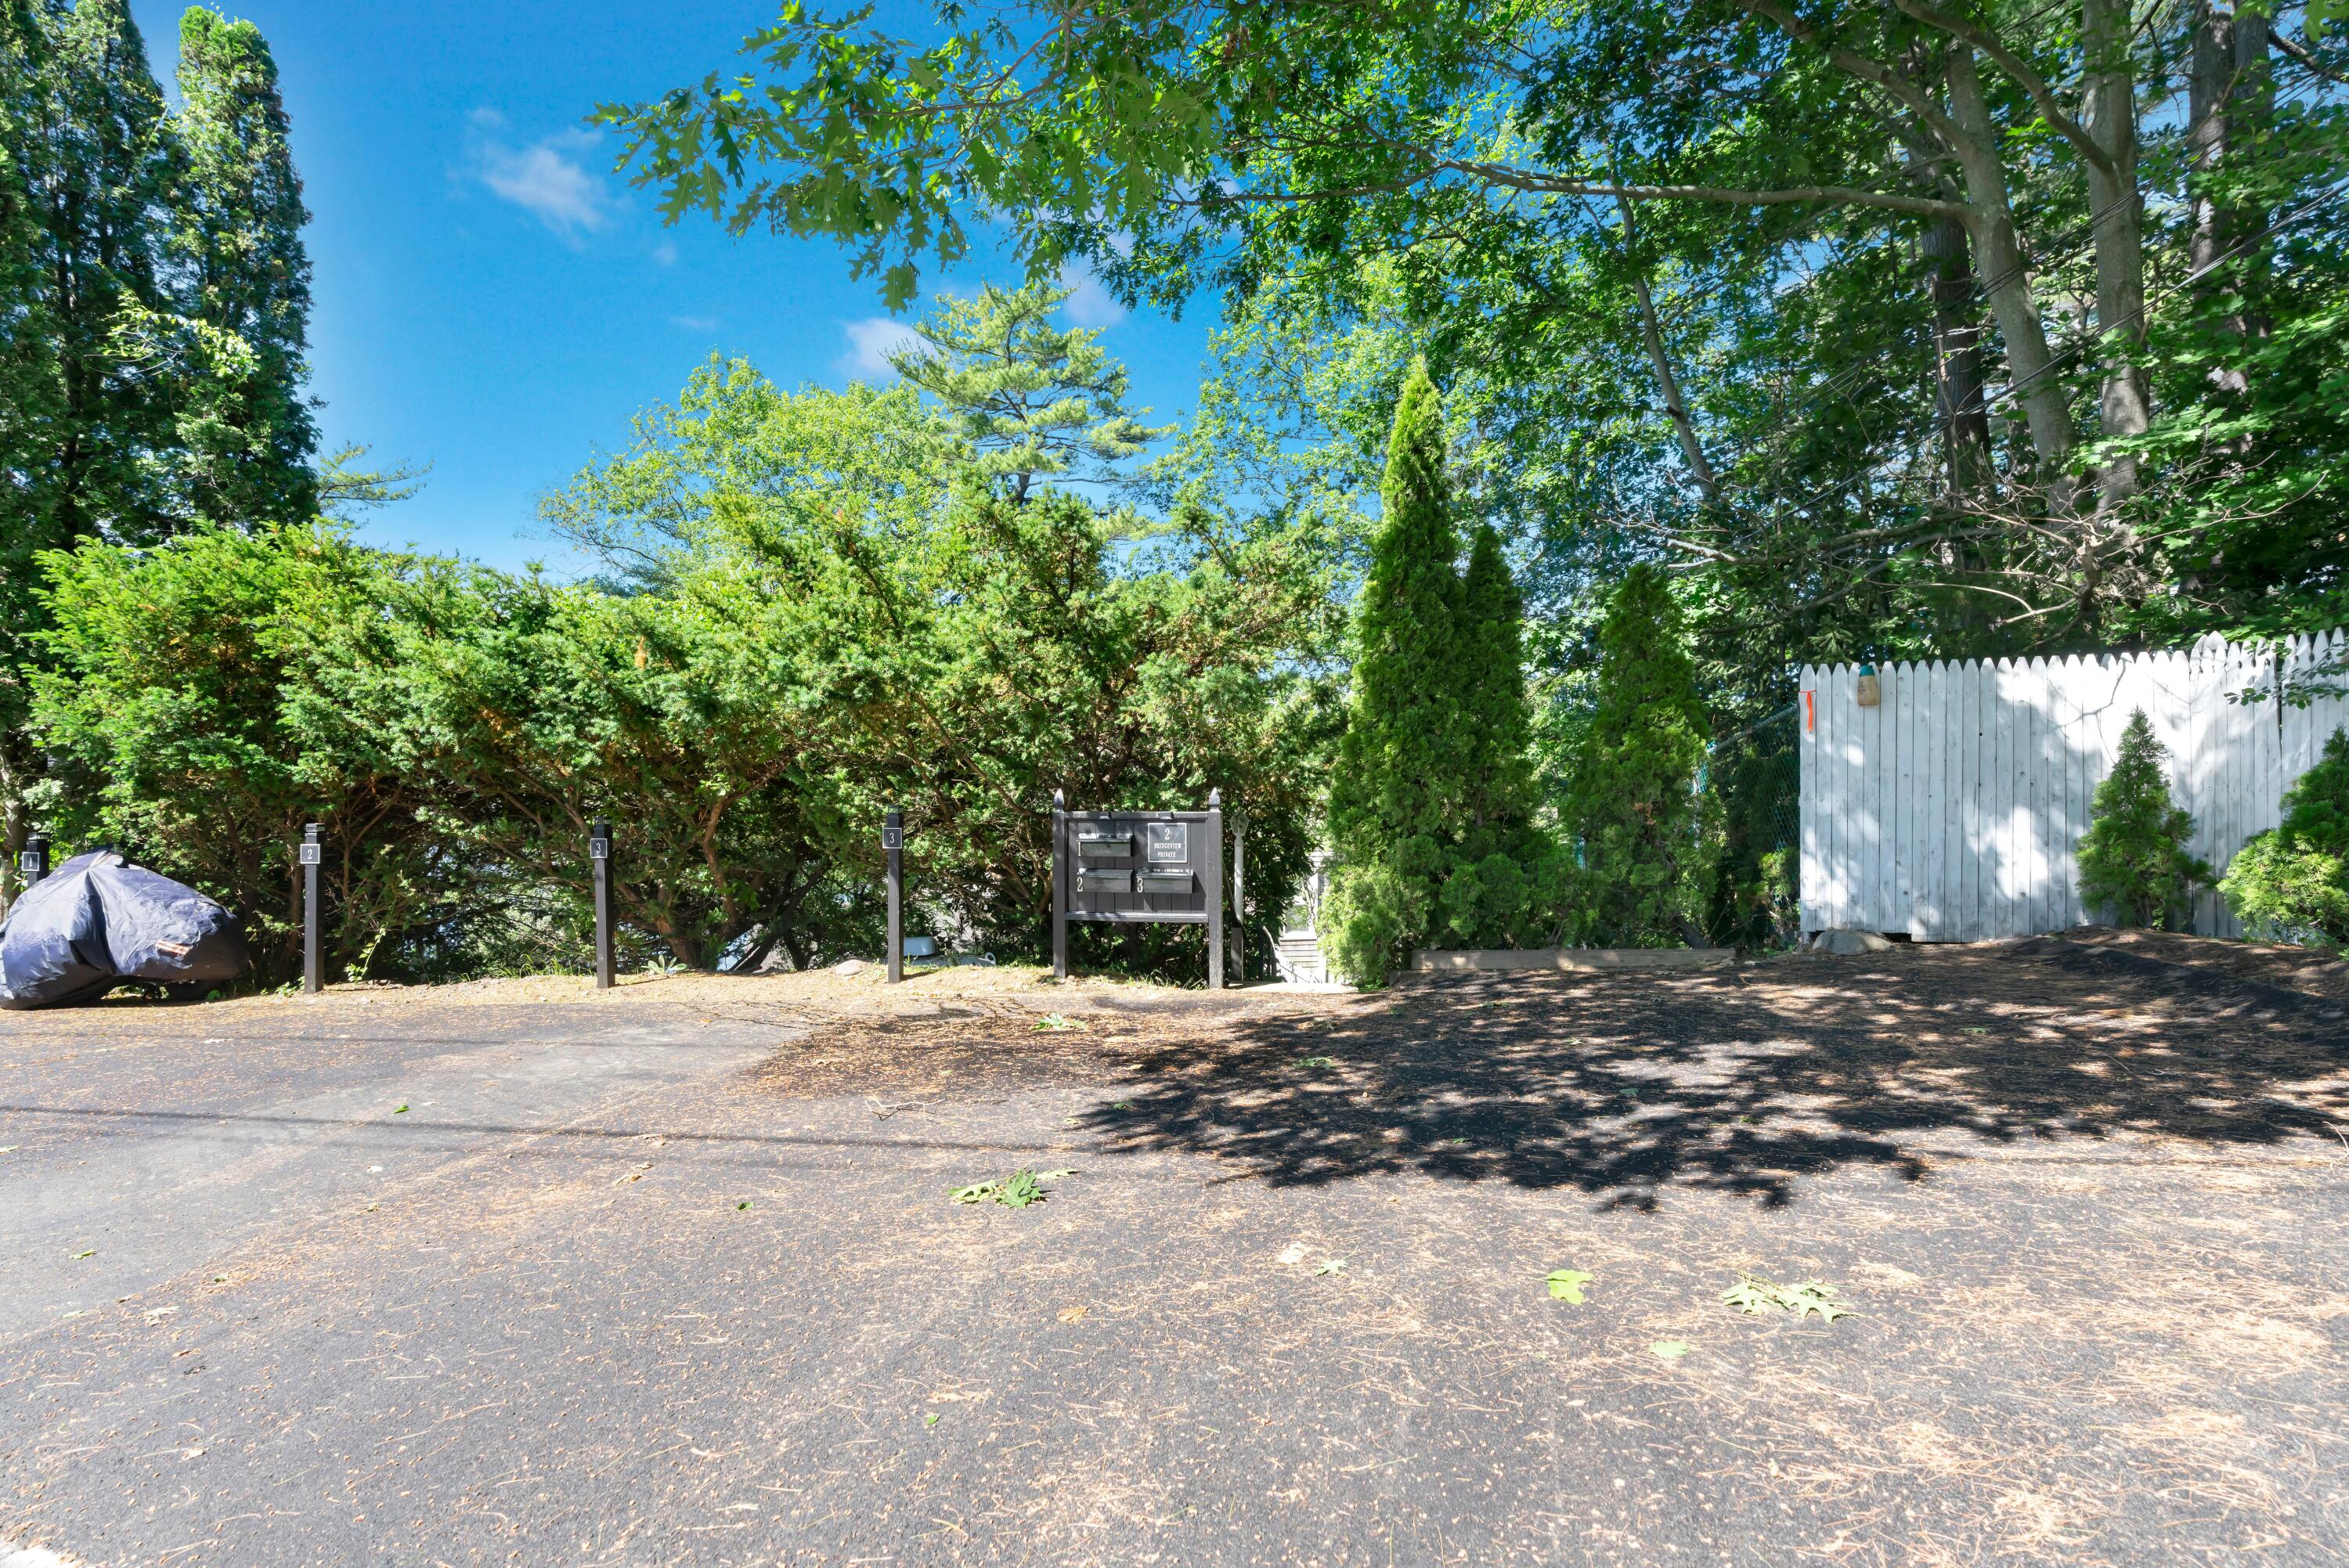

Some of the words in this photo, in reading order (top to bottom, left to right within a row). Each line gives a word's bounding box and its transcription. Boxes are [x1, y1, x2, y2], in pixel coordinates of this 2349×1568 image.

[889, 832, 895, 844] 3
[1164, 827, 1170, 840] 2
[596, 842, 601, 853] 3
[1077, 842, 1081, 856] 1
[307, 849, 312, 860] 2
[29, 857, 32, 867] 1
[1077, 877, 1083, 892] 2
[1137, 878, 1143, 892] 3
